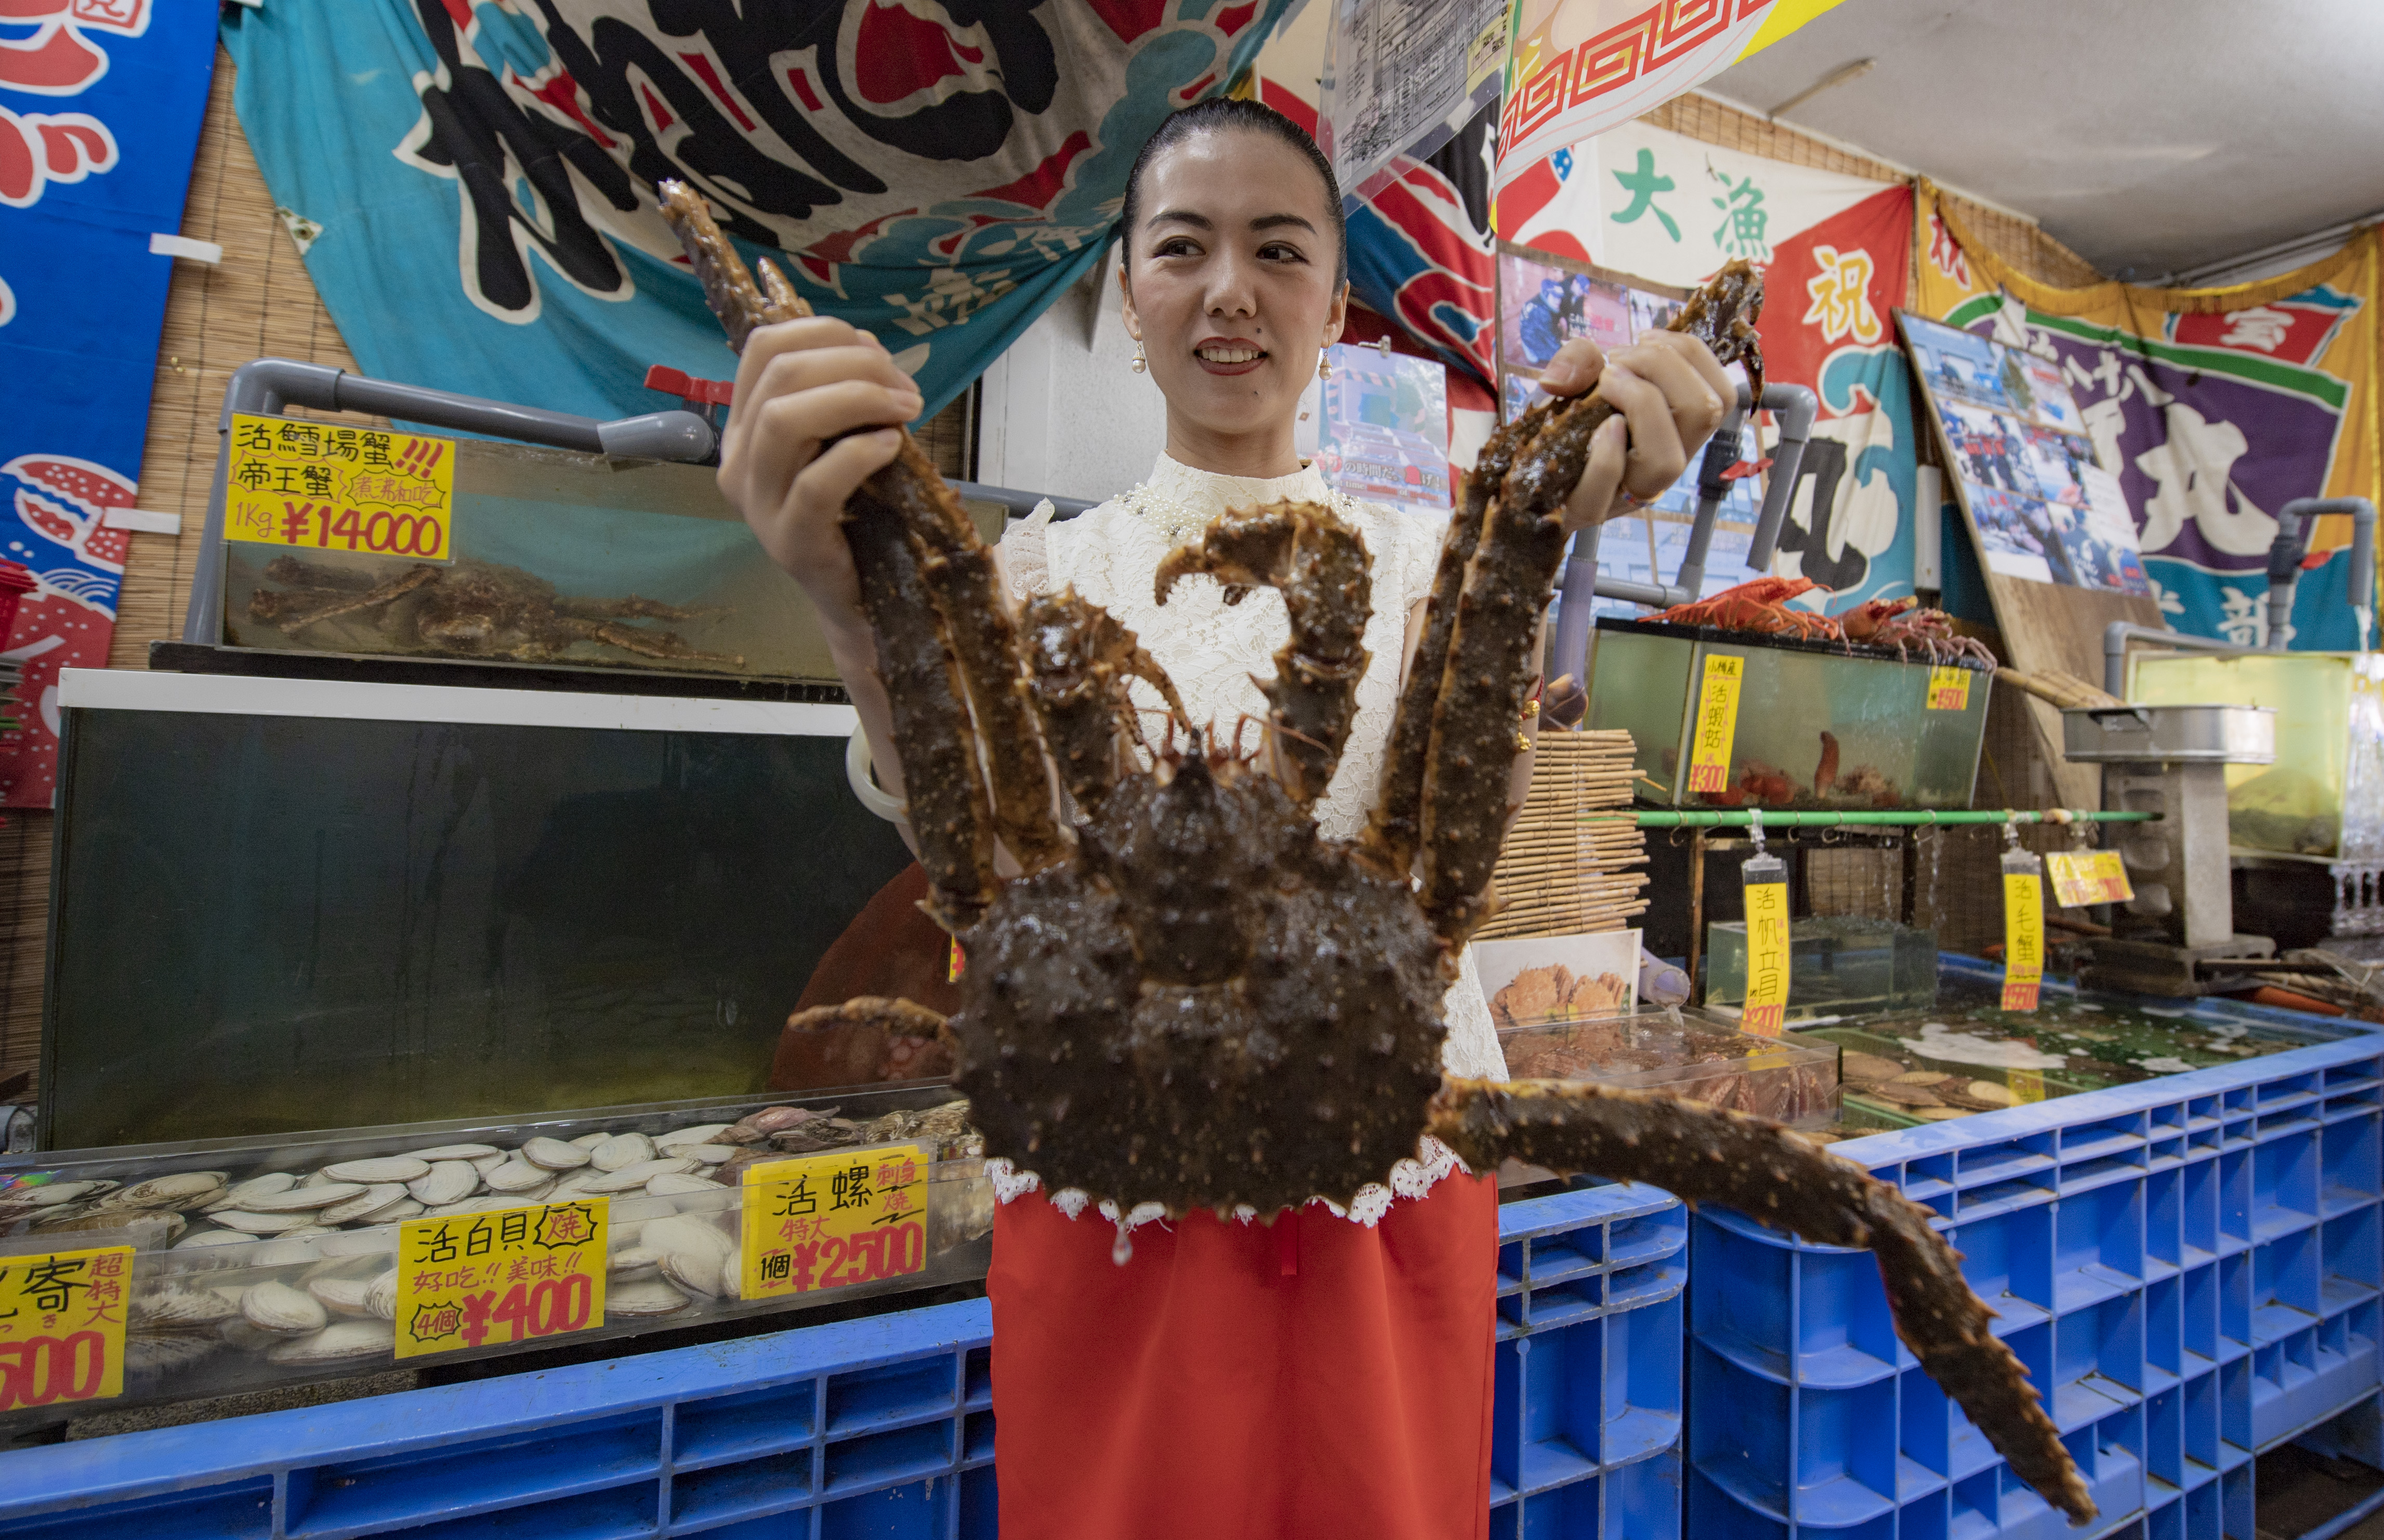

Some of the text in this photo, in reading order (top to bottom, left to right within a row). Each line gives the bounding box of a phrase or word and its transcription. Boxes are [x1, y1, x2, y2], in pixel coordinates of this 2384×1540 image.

[1610, 148, 1772, 258] 大漁
[1803, 246, 1881, 344] 祝
[238, 458, 333, 499] 帝王蟹
[1323, 477, 1343, 487] bout
[1346, 480, 1365, 490] time
[280, 501, 442, 557] ¥14000
[1690, 764, 1726, 792] ¥300
[1756, 887, 1781, 1004] 活帆立貝
[772, 1165, 873, 1216] 活螺
[876, 1157, 916, 1189] 刺身
[414, 1212, 527, 1263] 活白貝
[778, 1215, 833, 1243] 特大
[792, 1221, 924, 1293] ¥2500
[0, 1256, 91, 1318] 寄
[81, 1253, 125, 1326] 超特大
[417, 1273, 592, 1348] 4個 ¥400
